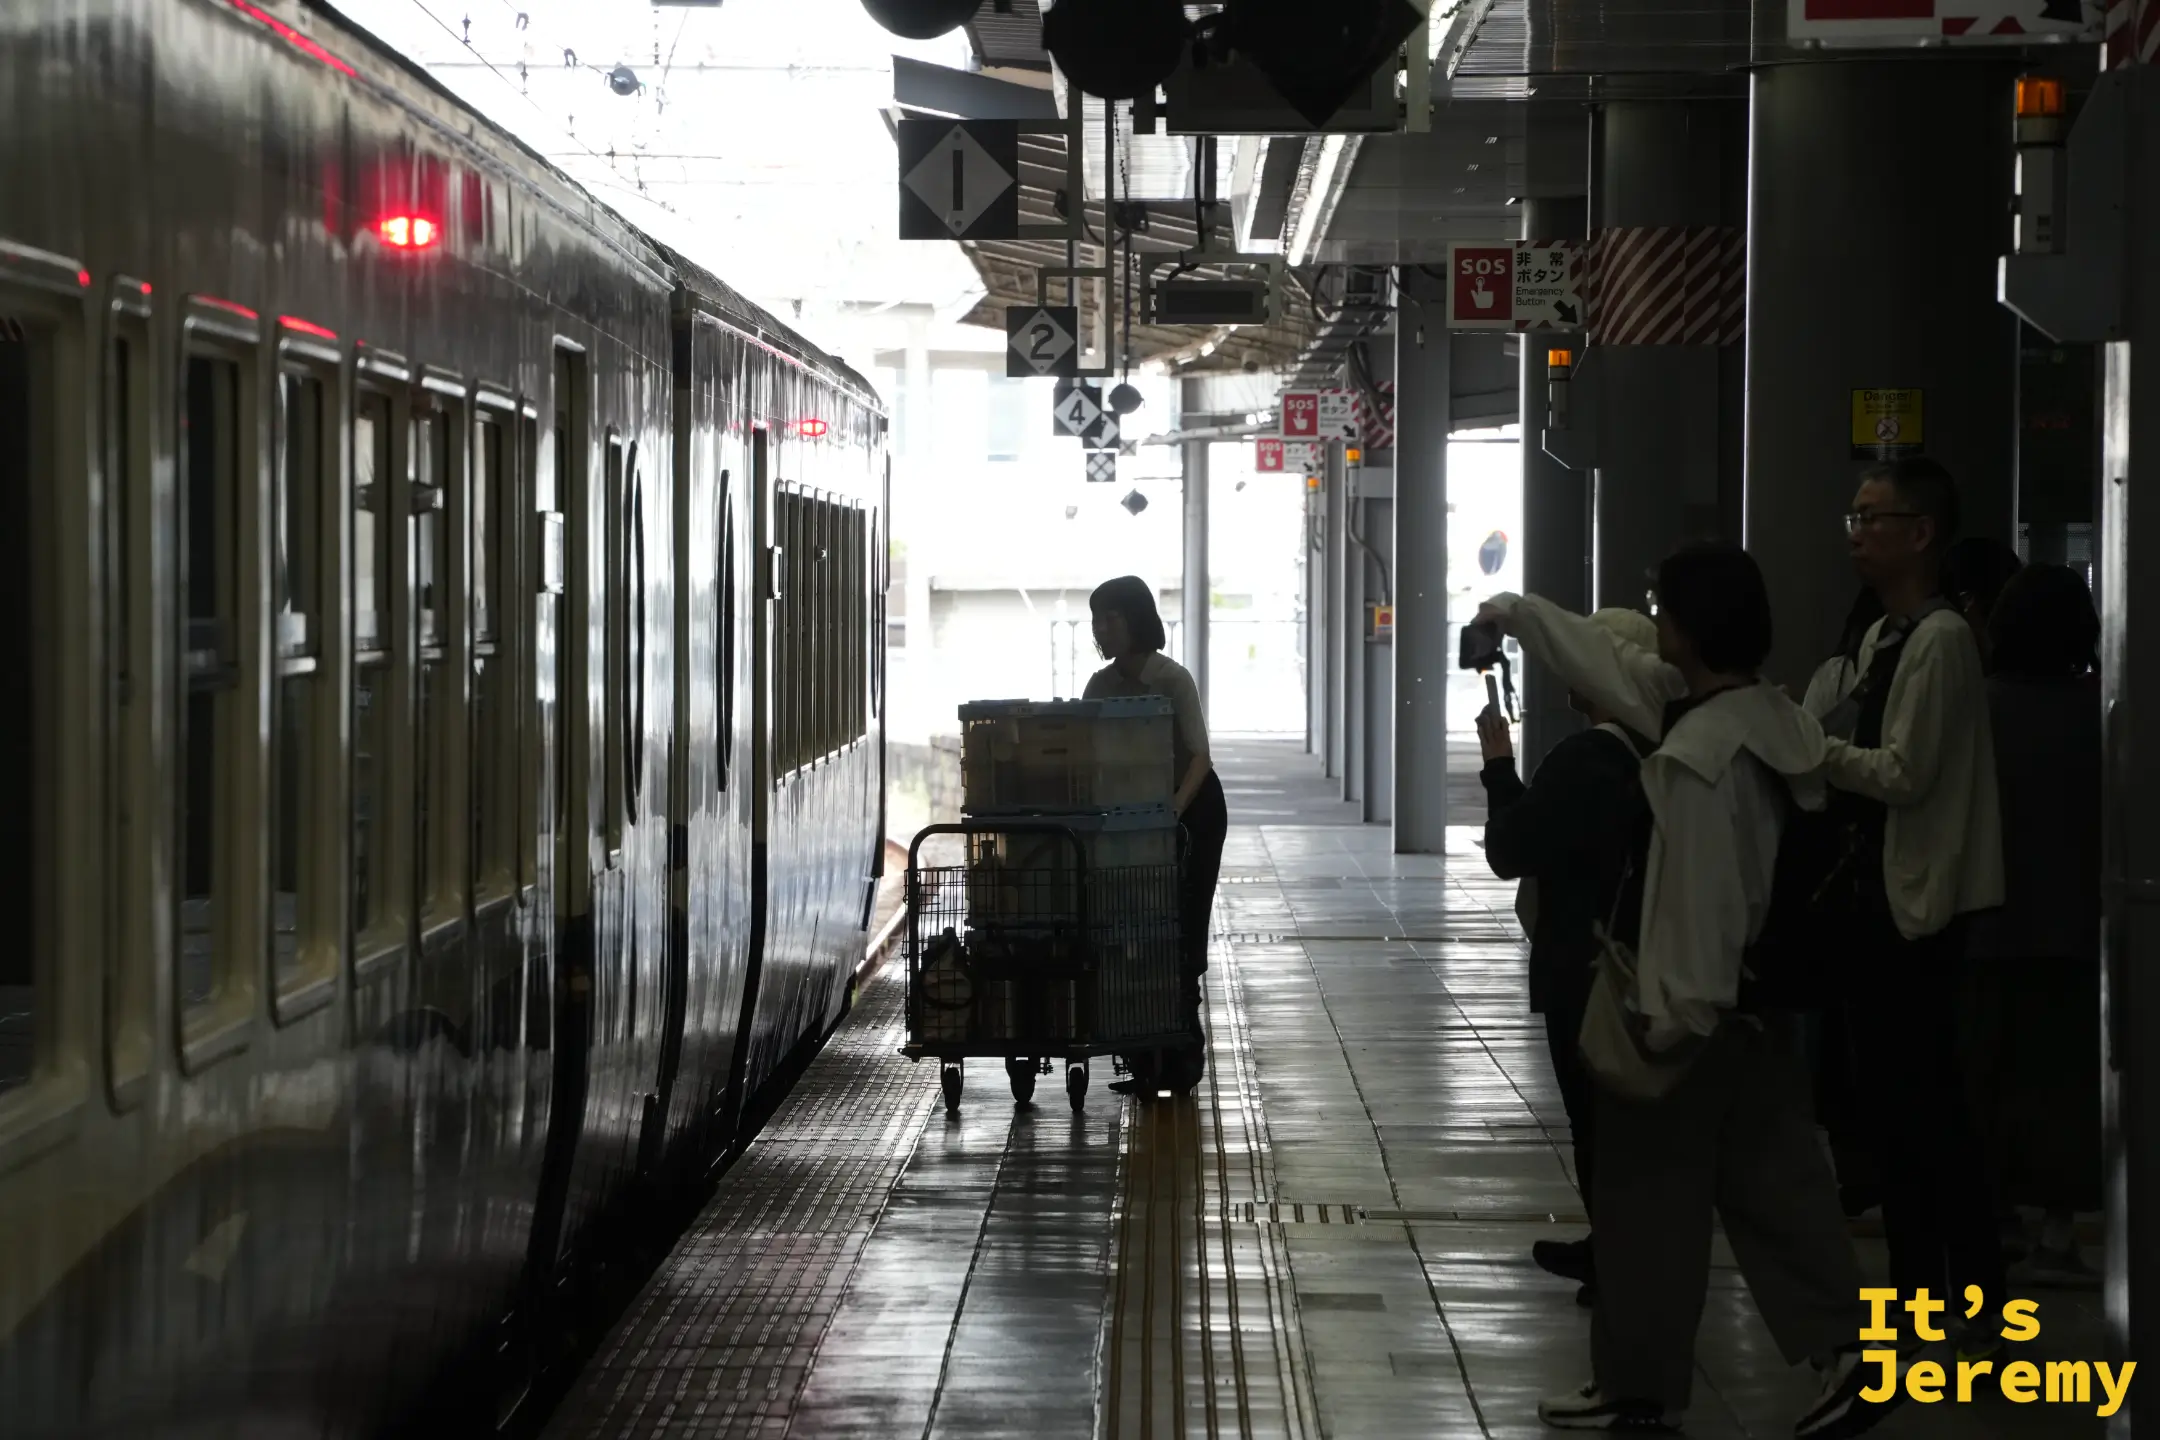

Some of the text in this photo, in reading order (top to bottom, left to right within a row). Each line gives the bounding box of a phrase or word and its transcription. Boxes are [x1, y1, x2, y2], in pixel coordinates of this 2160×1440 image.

[1461, 258, 1506, 275] SOS
[1516, 251, 1564, 267] 非常
[1516, 268, 1564, 283] ボタン
[1516, 286, 1565, 297] Emergency
[1516, 296, 1546, 306] Button
[1030, 323, 1054, 360] 2
[1068, 399, 1086, 425] 4
[1287, 399, 1314, 410] SOS
